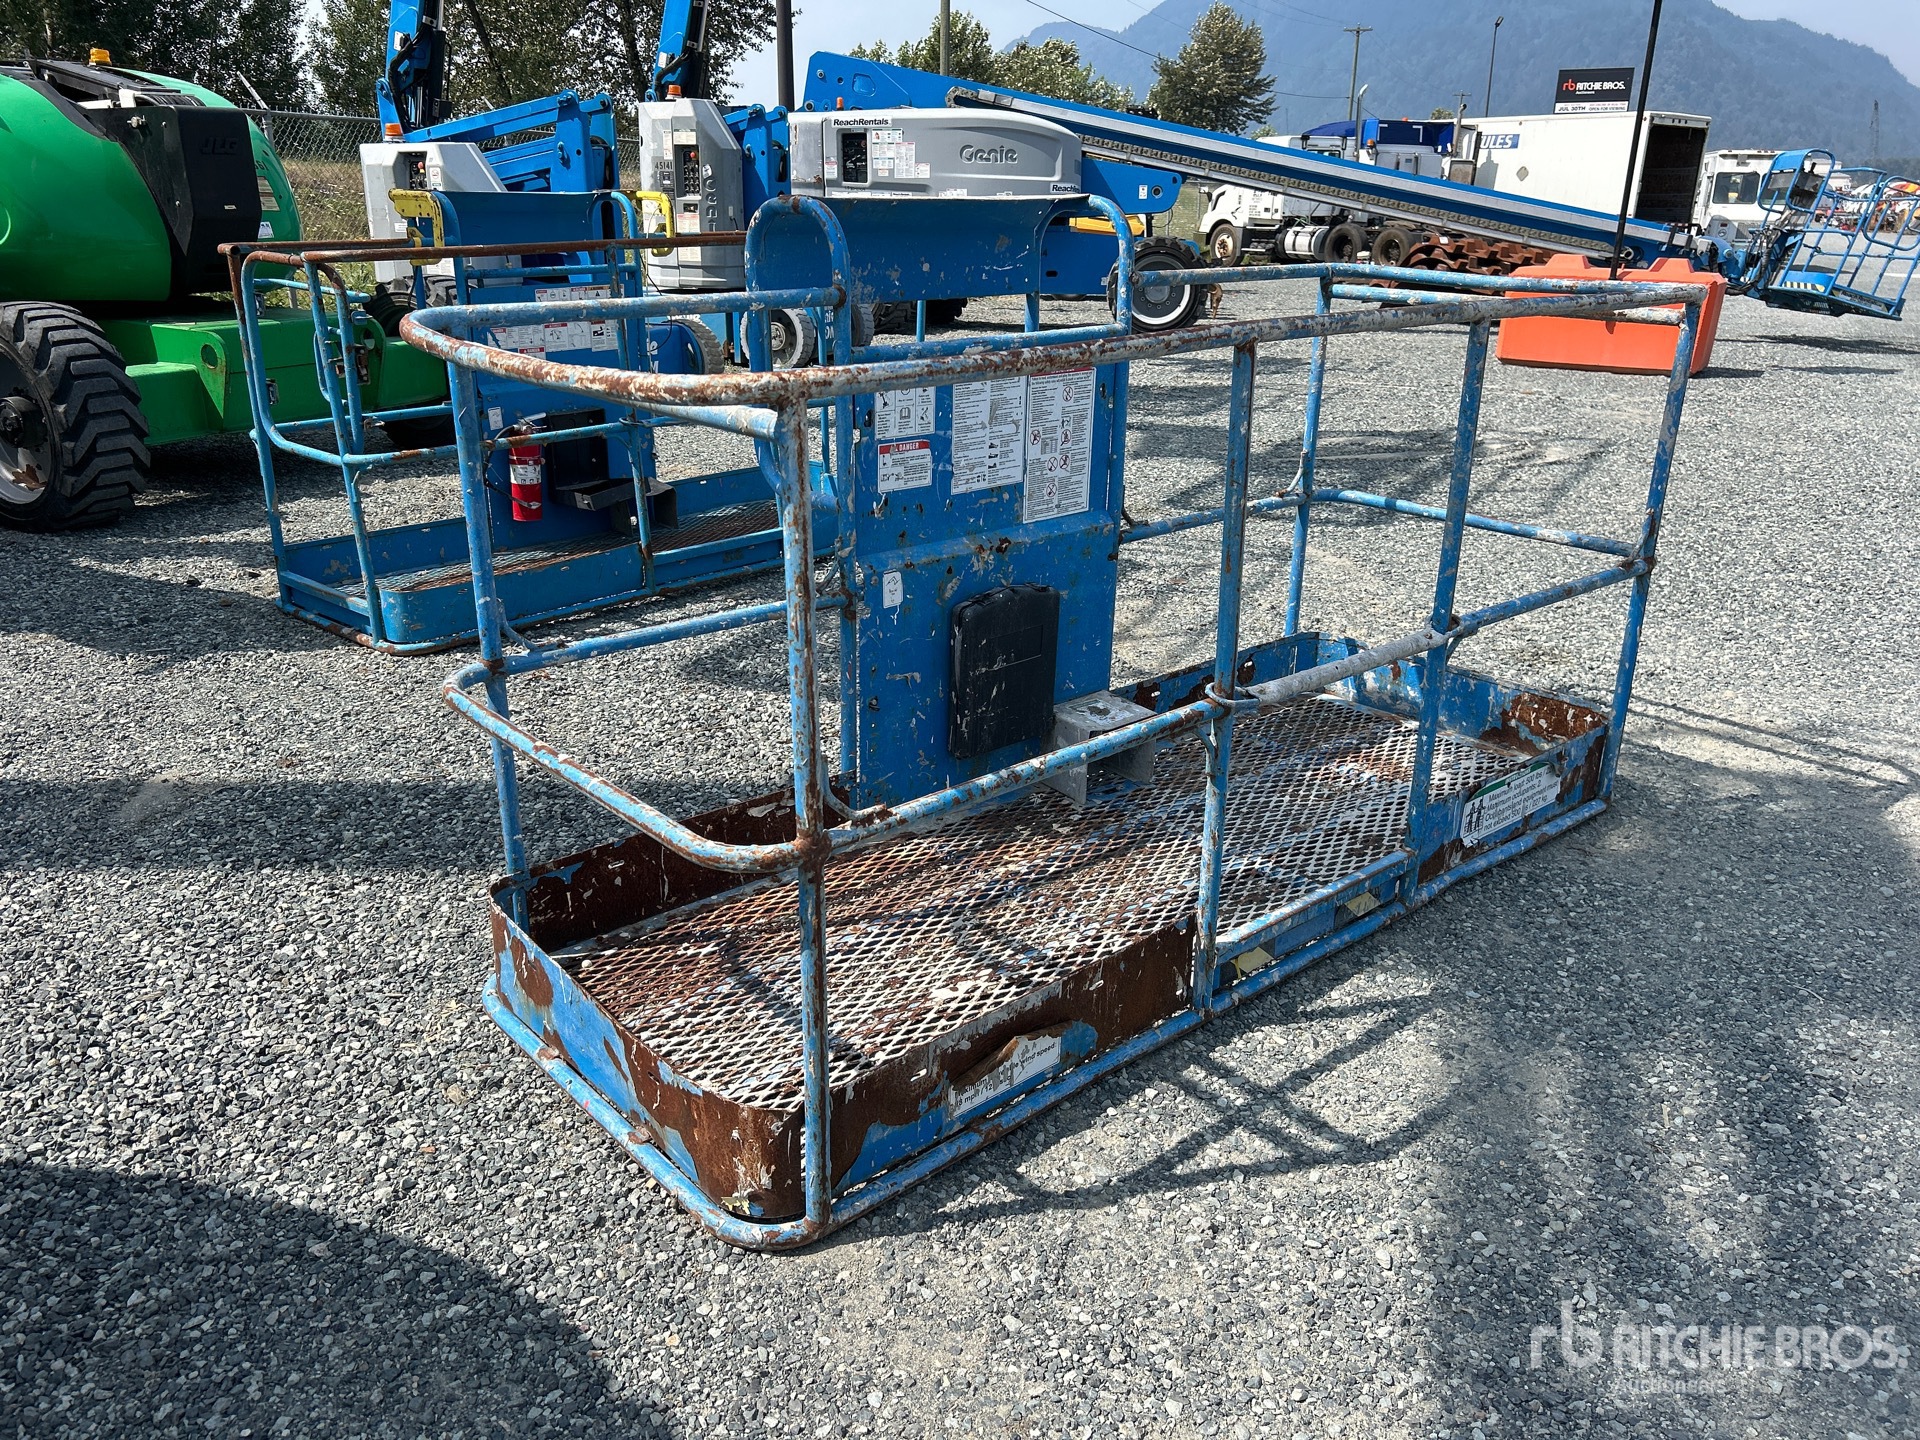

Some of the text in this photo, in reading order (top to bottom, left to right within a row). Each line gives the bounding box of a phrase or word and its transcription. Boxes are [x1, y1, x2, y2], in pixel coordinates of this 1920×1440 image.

[1576, 82, 1602, 90] RITCHIE
[1603, 81, 1626, 90] BROS.
[833, 118, 889, 126] ReachRentals
[1480, 135, 1514, 149] ULES
[959, 144, 1018, 164] Genie
[899, 442, 919, 452] DANGER
[1021, 1051, 1036, 1064] wind
